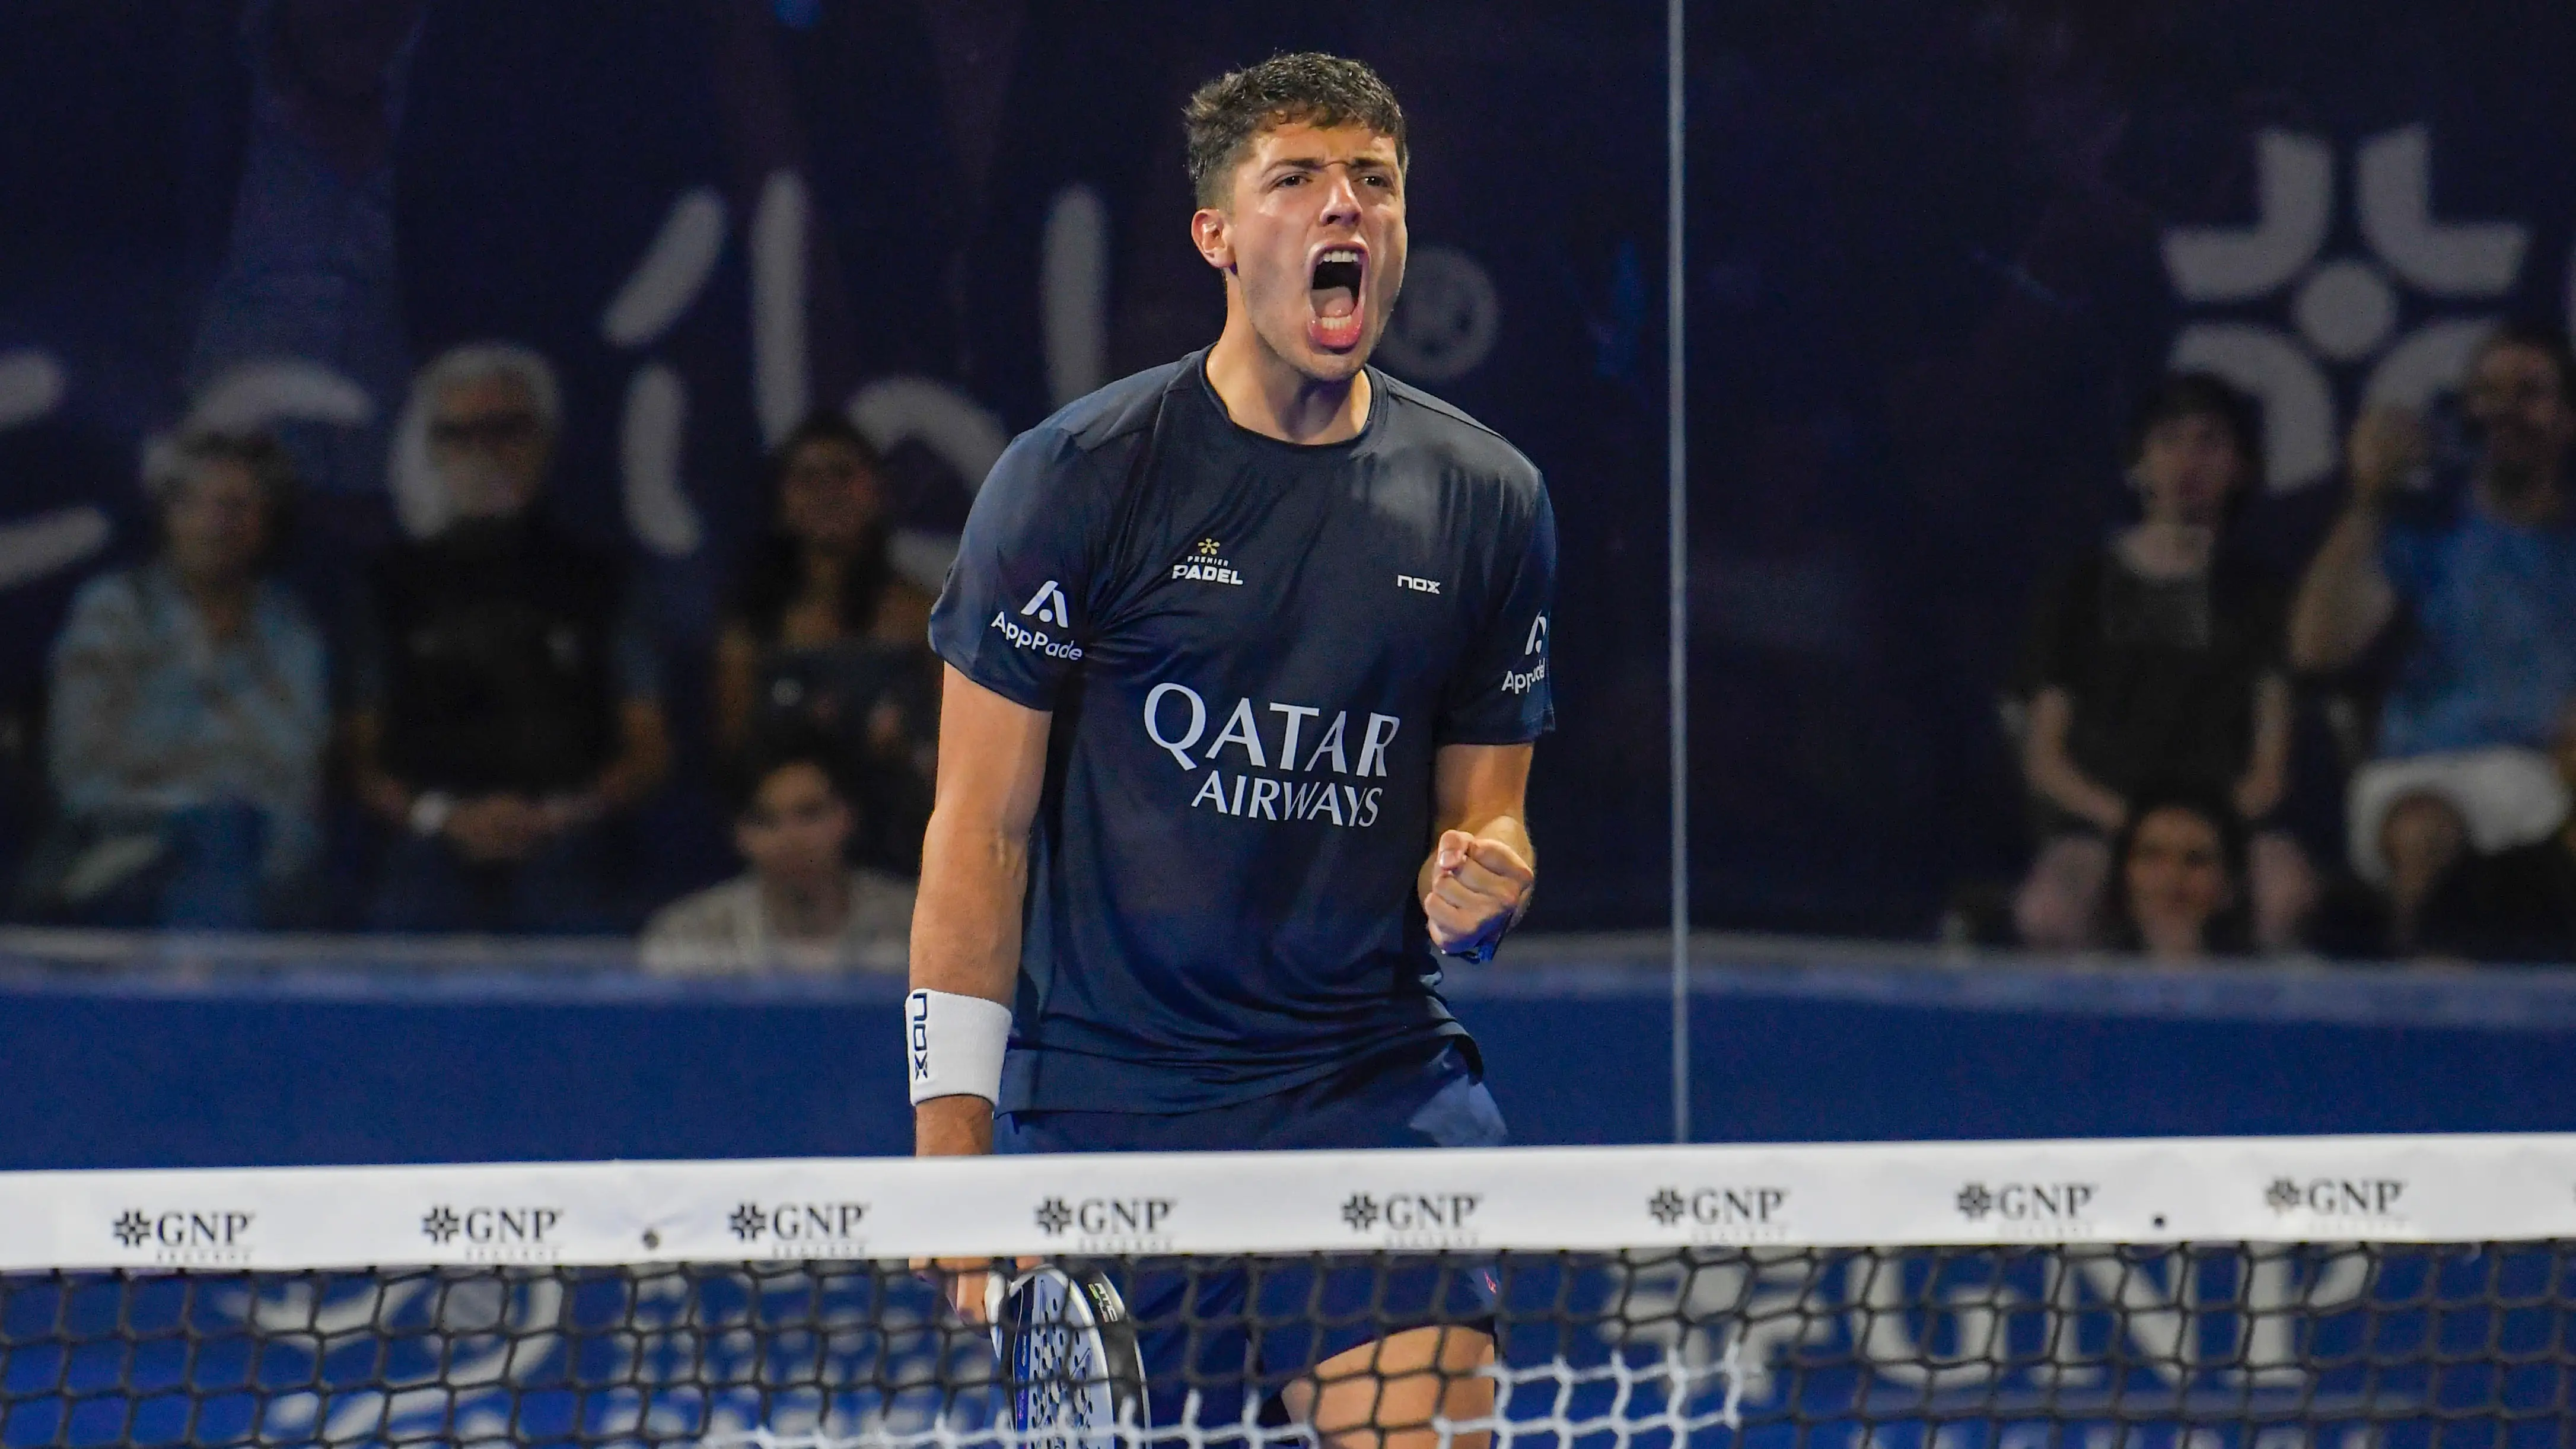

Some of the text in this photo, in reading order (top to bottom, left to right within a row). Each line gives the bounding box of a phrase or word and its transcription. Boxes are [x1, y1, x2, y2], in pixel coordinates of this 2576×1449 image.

[1171, 564, 1244, 585] PADEL
[1187, 556, 1228, 567] PREMIER
[1144, 682, 1400, 778] QATAR
[1190, 770, 1383, 827] AIRWAYS
[1386, 1192, 1475, 1231] GNP
[1692, 1187, 1783, 1225] GNP
[1999, 1183, 2091, 1221] GNP
[2308, 1177, 2401, 1216] GNP
[157, 1209, 249, 1247] GNP
[465, 1206, 556, 1243] GNP
[773, 1201, 863, 1240] GNP
[1079, 1198, 1170, 1235] GNP
